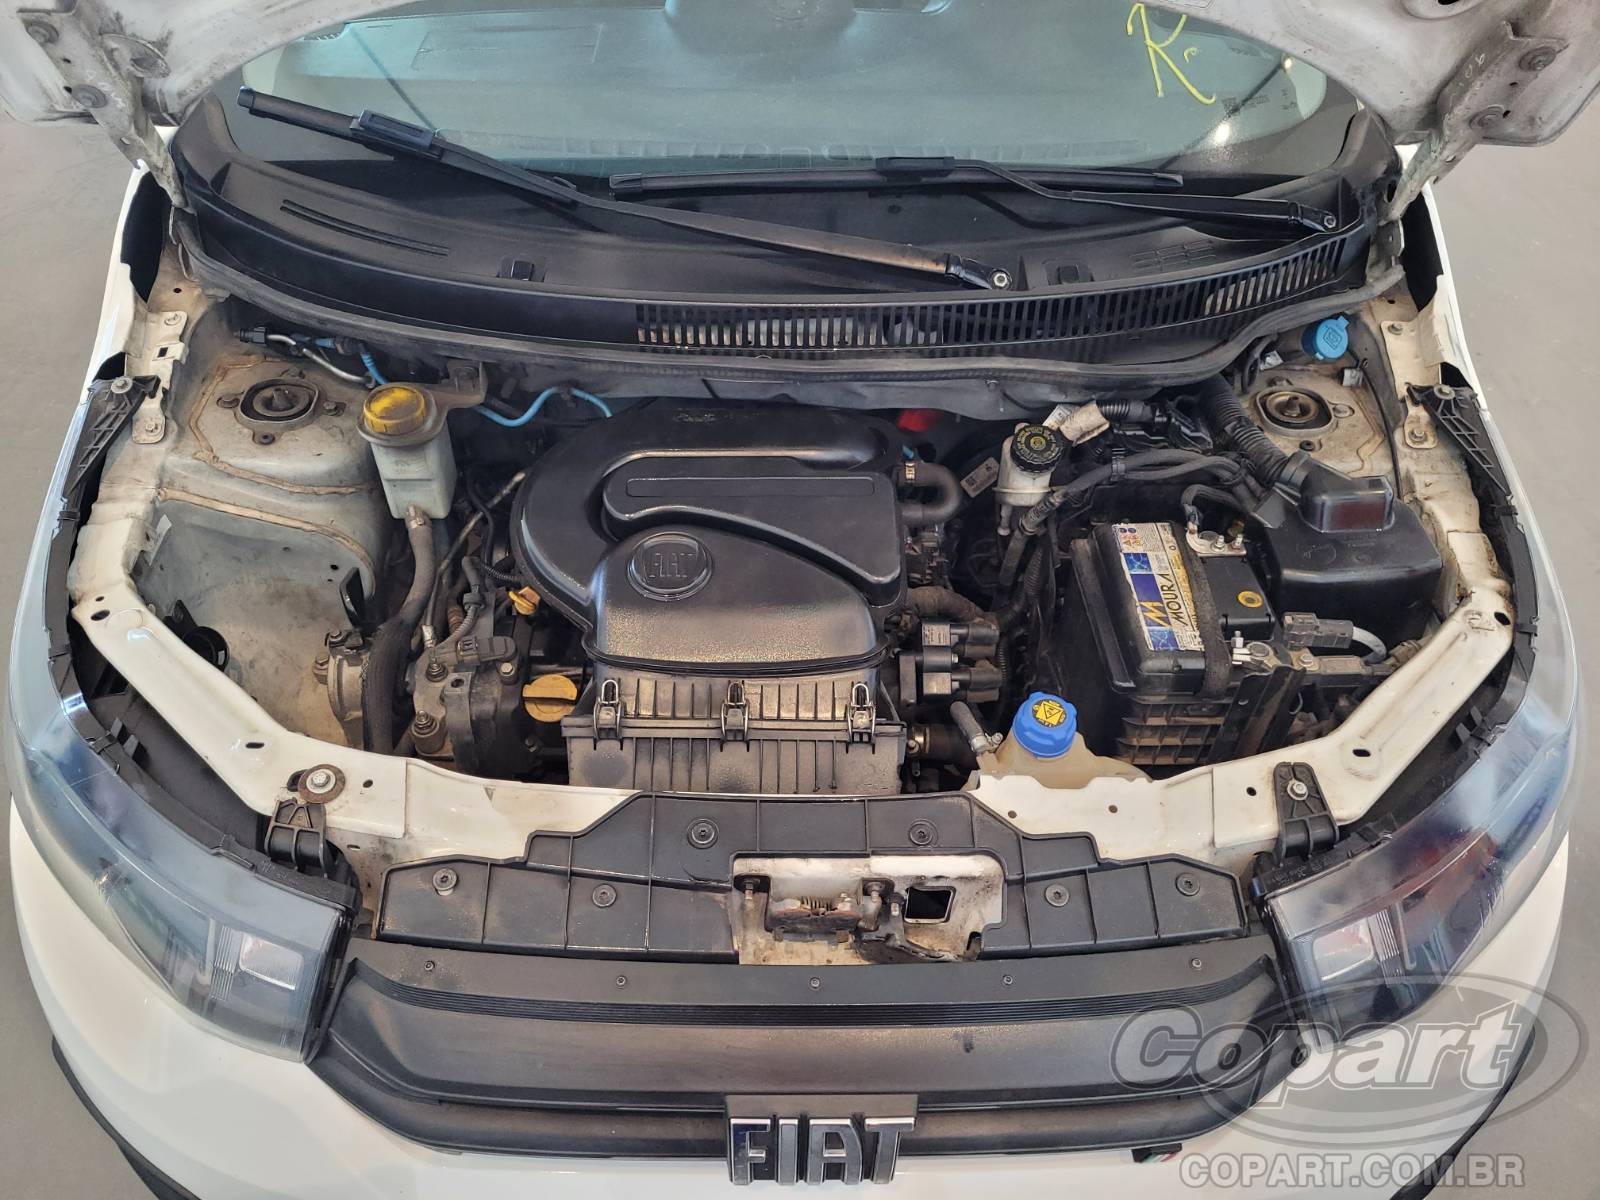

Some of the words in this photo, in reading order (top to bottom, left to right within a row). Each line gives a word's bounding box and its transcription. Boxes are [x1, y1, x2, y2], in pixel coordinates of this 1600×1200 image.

[647, 552, 698, 578] FIAT
[1157, 573, 1188, 627] MOURA
[730, 1117, 916, 1185] FIAT
